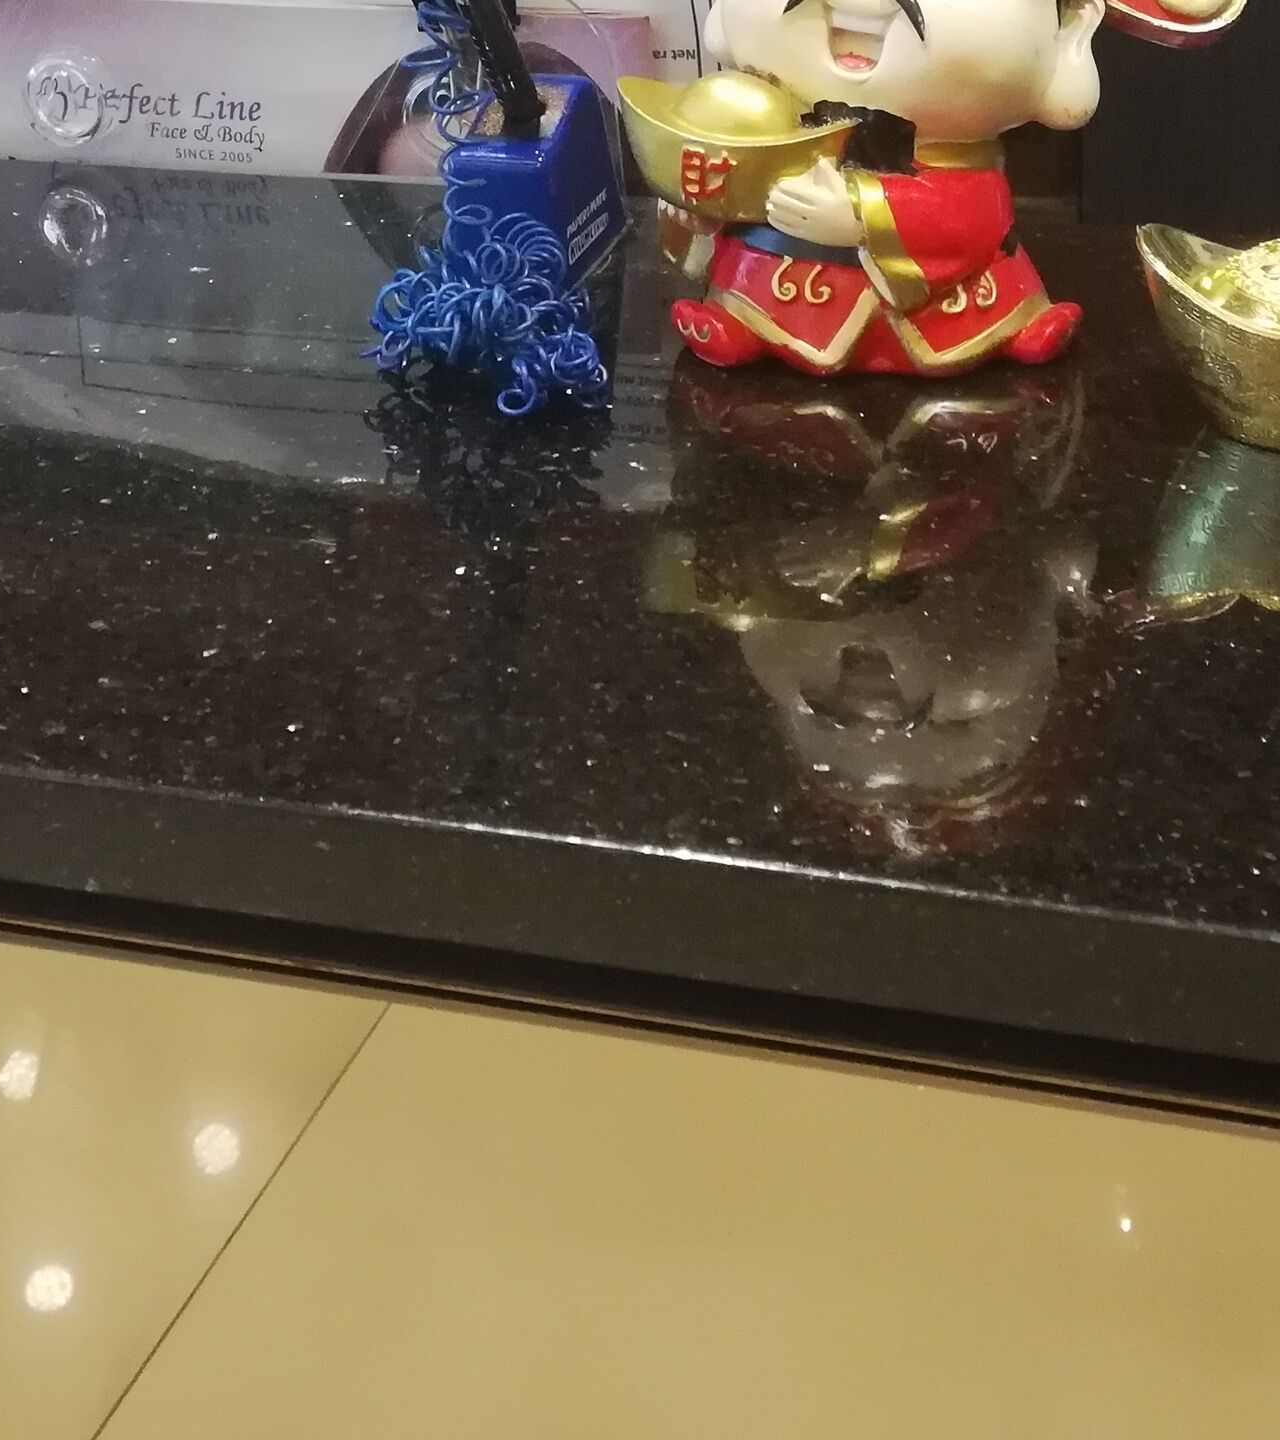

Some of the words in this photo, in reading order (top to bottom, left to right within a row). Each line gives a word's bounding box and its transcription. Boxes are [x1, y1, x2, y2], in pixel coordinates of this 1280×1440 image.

[652, 50, 670, 59] ra
[672, 48, 697, 60] Net
[192, 90, 263, 122] Line
[148, 121, 188, 139] Face
[217, 125, 266, 152] Body
[175, 147, 216, 161] SINCE
[219, 150, 254, 163] 2005
